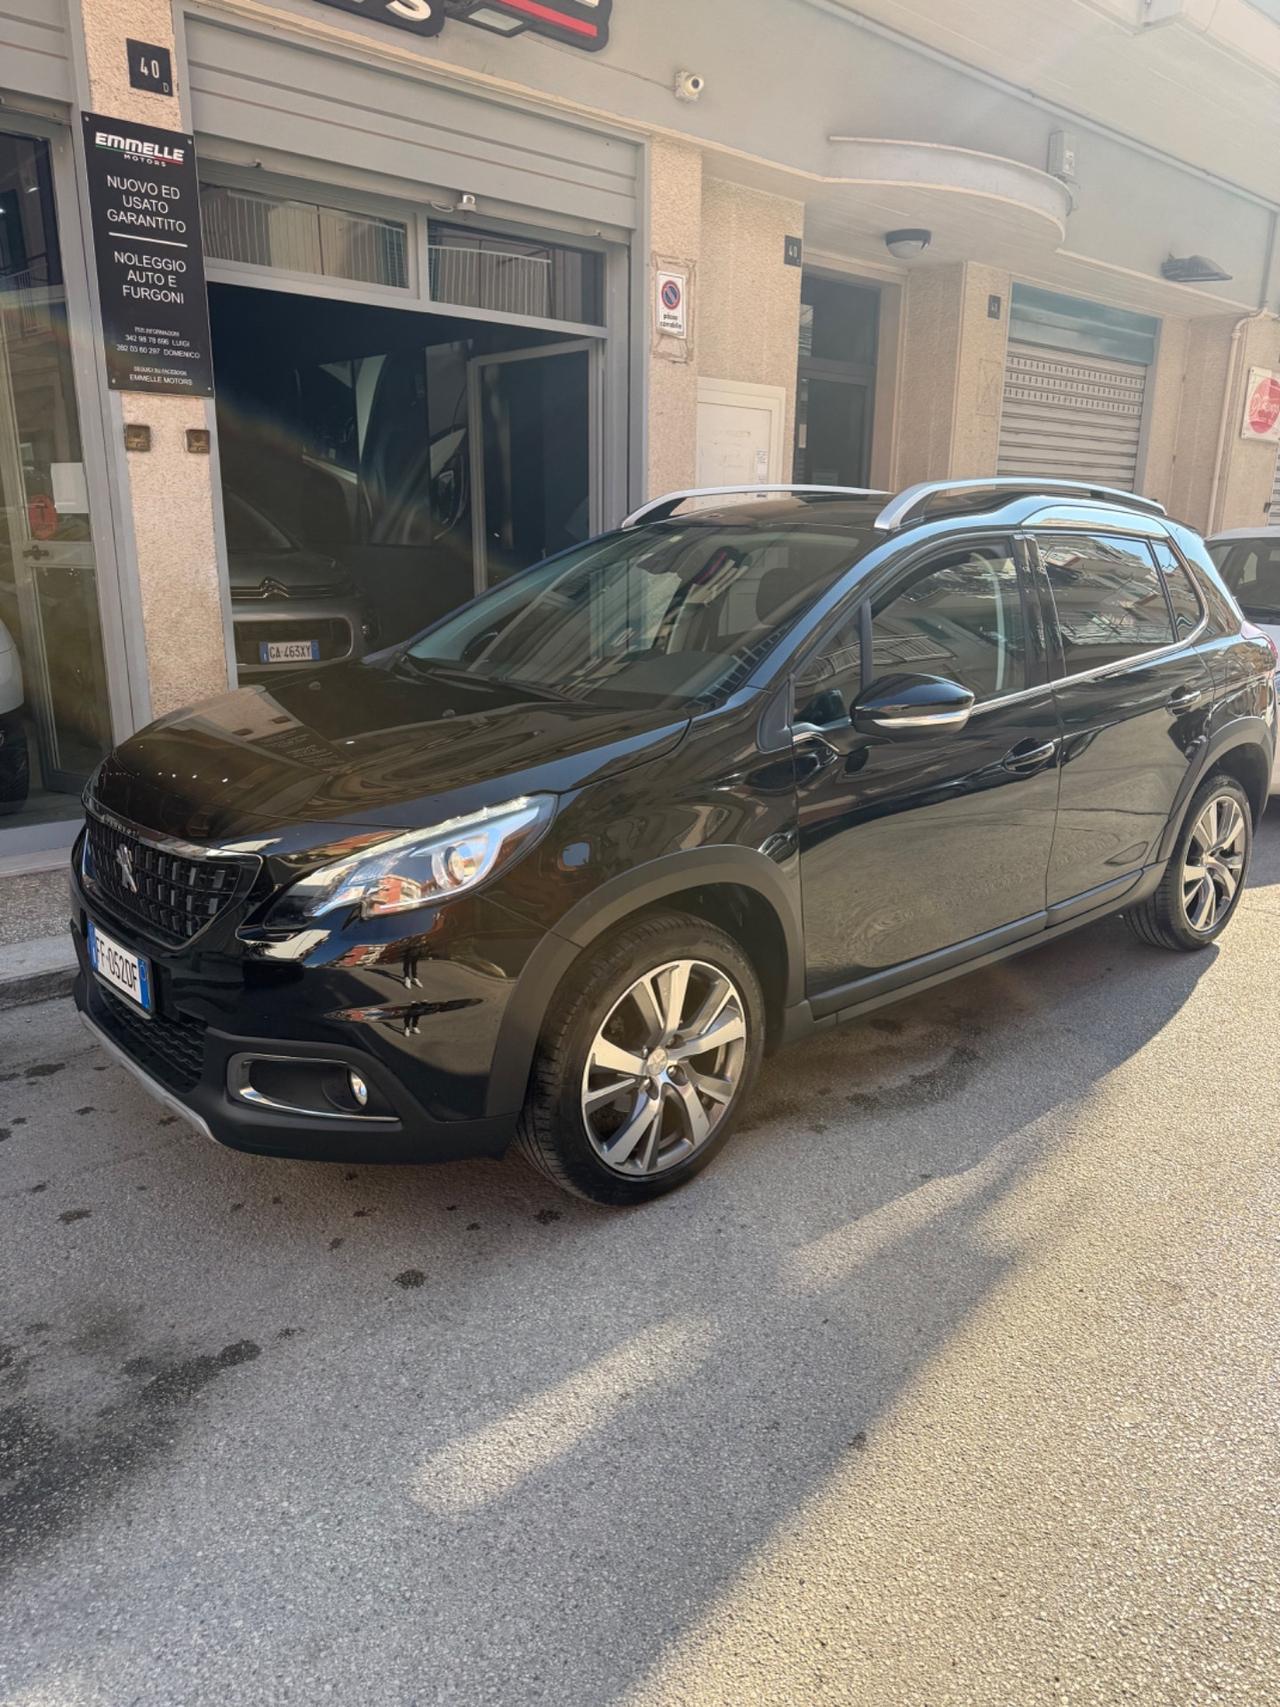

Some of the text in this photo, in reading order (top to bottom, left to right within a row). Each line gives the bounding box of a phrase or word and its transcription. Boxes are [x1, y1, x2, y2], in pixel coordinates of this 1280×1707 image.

[140, 57, 160, 79] 40
[95, 131, 185, 162] EMMELLE
[124, 154, 167, 167] MOTORS
[106, 174, 181, 200] NUOVO ED
[122, 195, 169, 214] USATO
[106, 208, 187, 233] GARANTITO
[113, 251, 187, 273] NOLEGGIO
[127, 269, 178, 288] AUTO E
[122, 284, 185, 304] FURGONI
[171, 339, 191, 348] LUIGI
[163, 348, 201, 359] DOMENICO
[129, 373, 193, 386] EMMELLE MOTORS
